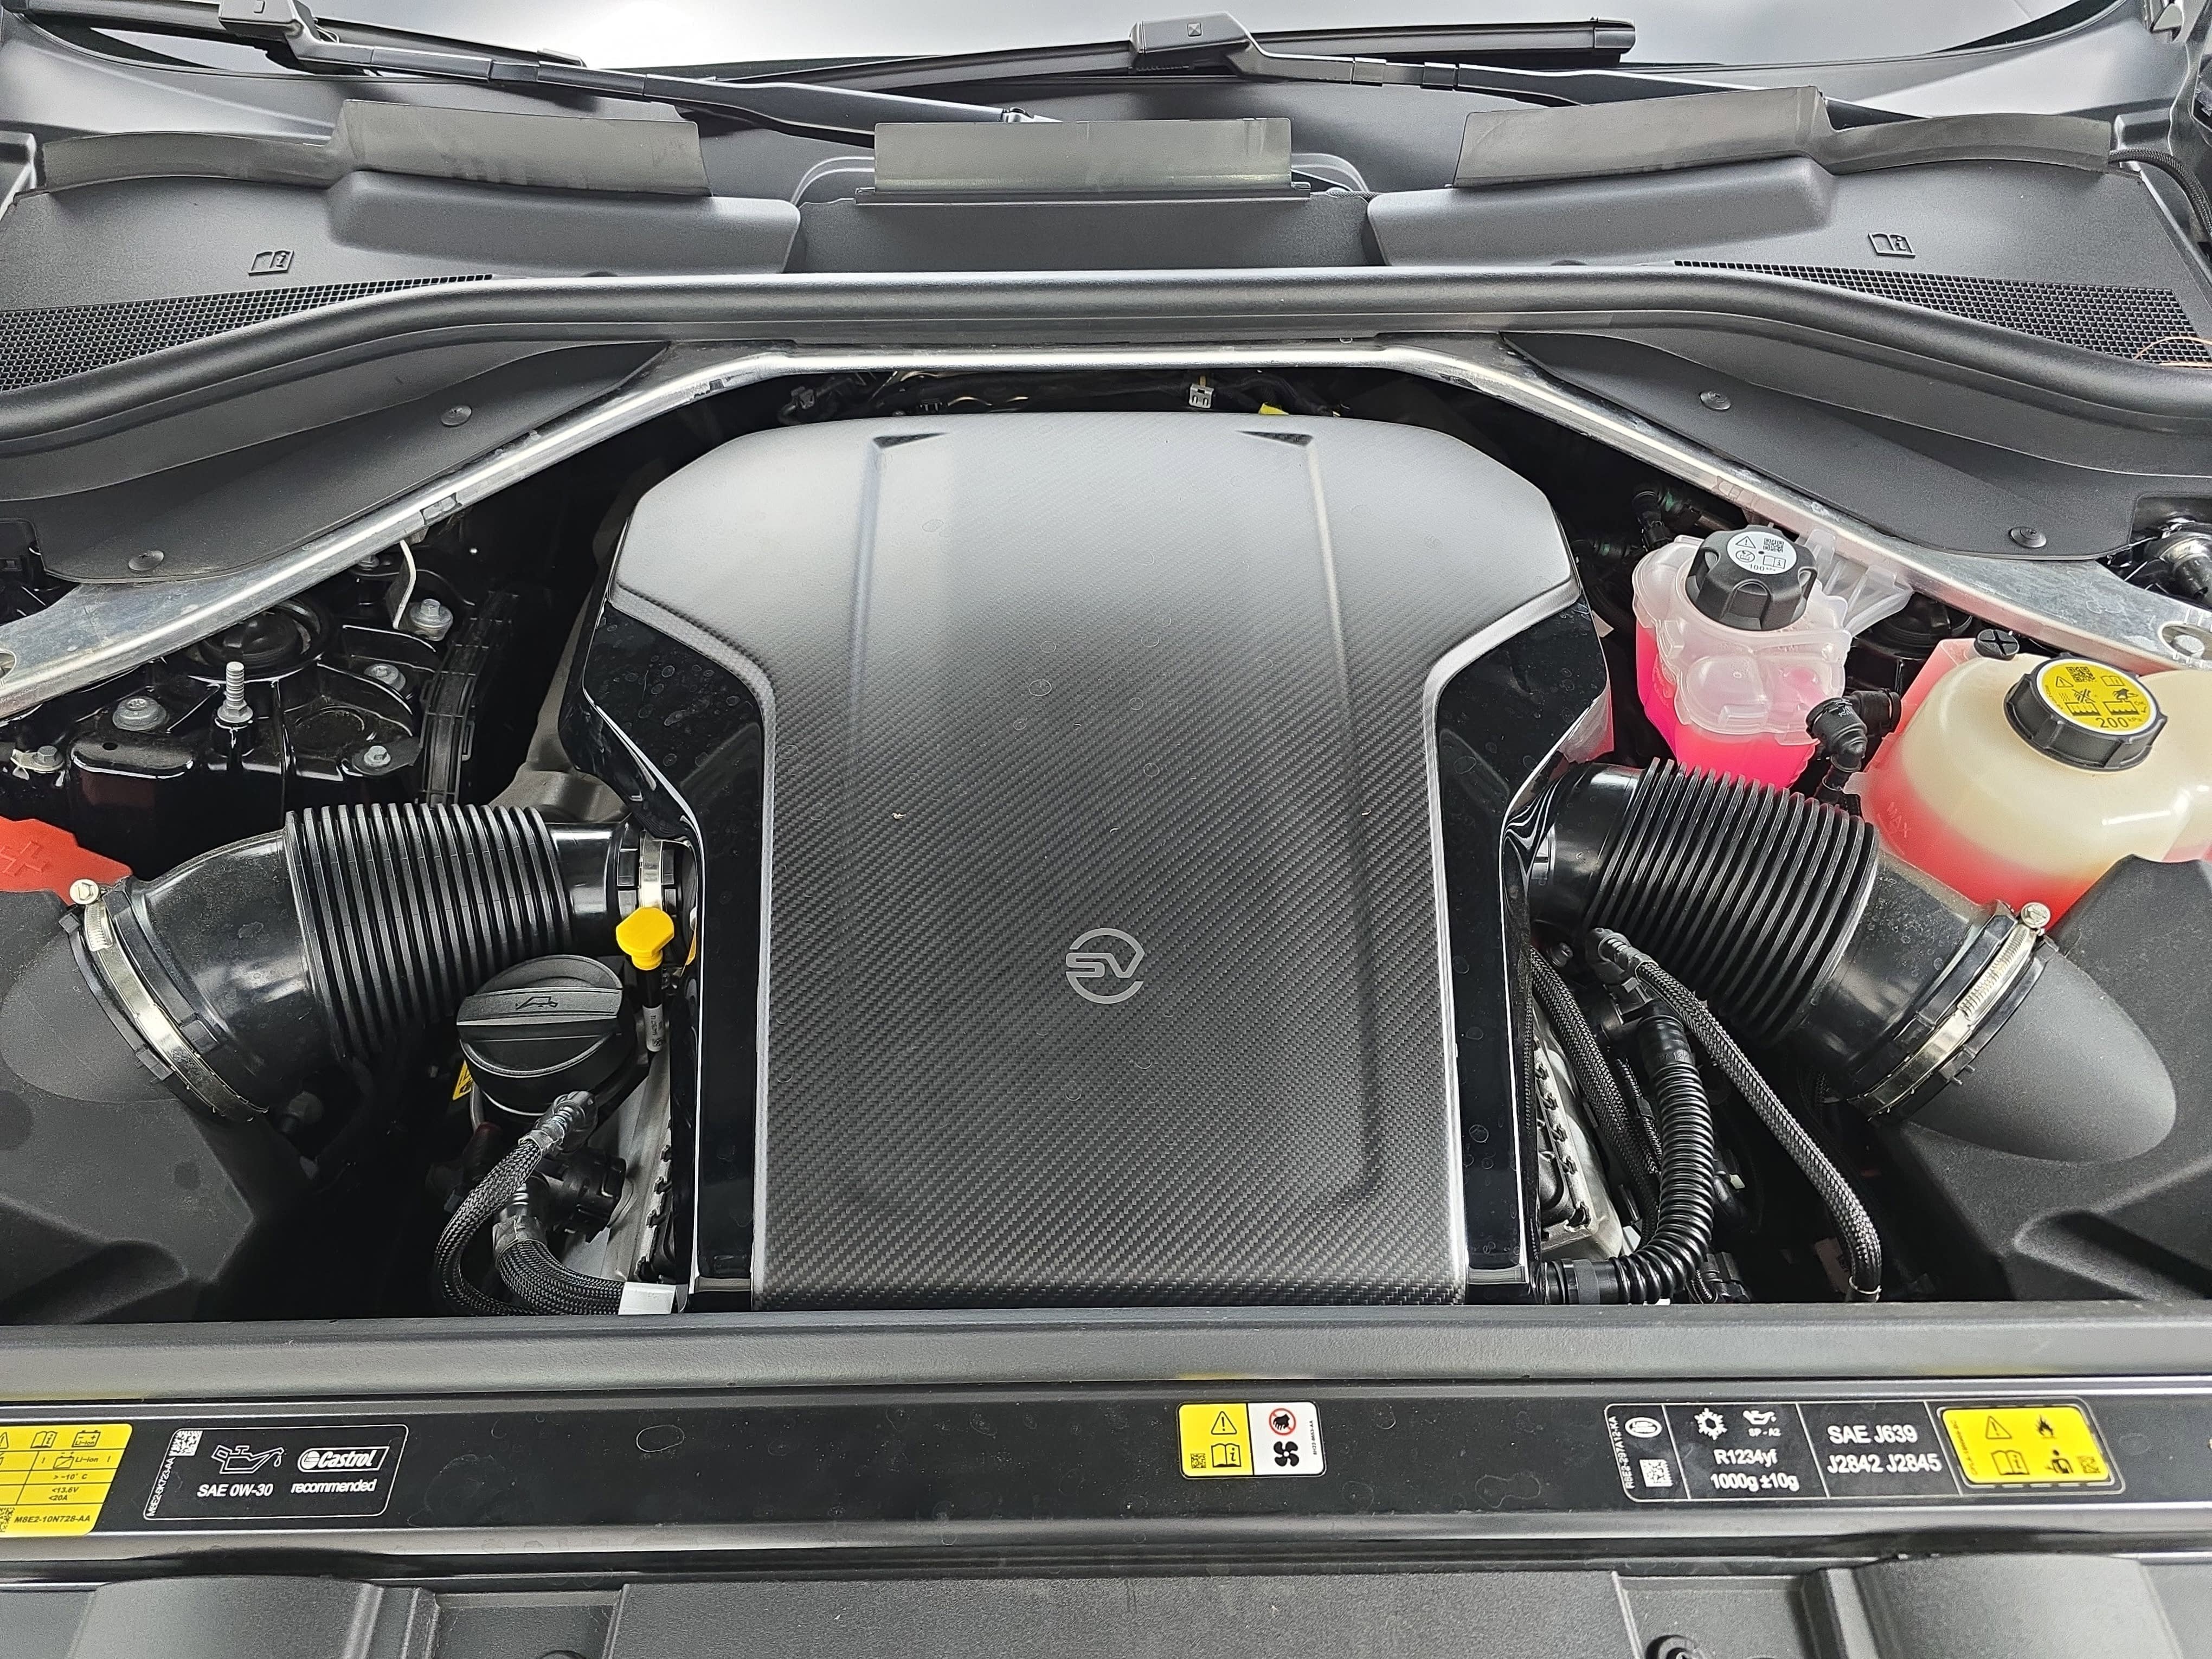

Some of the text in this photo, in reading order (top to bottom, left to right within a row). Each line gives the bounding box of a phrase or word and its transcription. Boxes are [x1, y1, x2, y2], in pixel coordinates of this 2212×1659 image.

[2095, 717, 2129, 728] 200
[1828, 1424, 1919, 1444] SAE J639
[318, 1450, 378, 1468] Castrol
[1713, 1449, 1778, 1467] R1234yf
[1827, 1454, 1942, 1474] J2842 J2845
[197, 1483, 274, 1497] SAE 0W-30
[291, 1478, 378, 1493] recommended
[1710, 1472, 1800, 1492] 1000g ±10g
